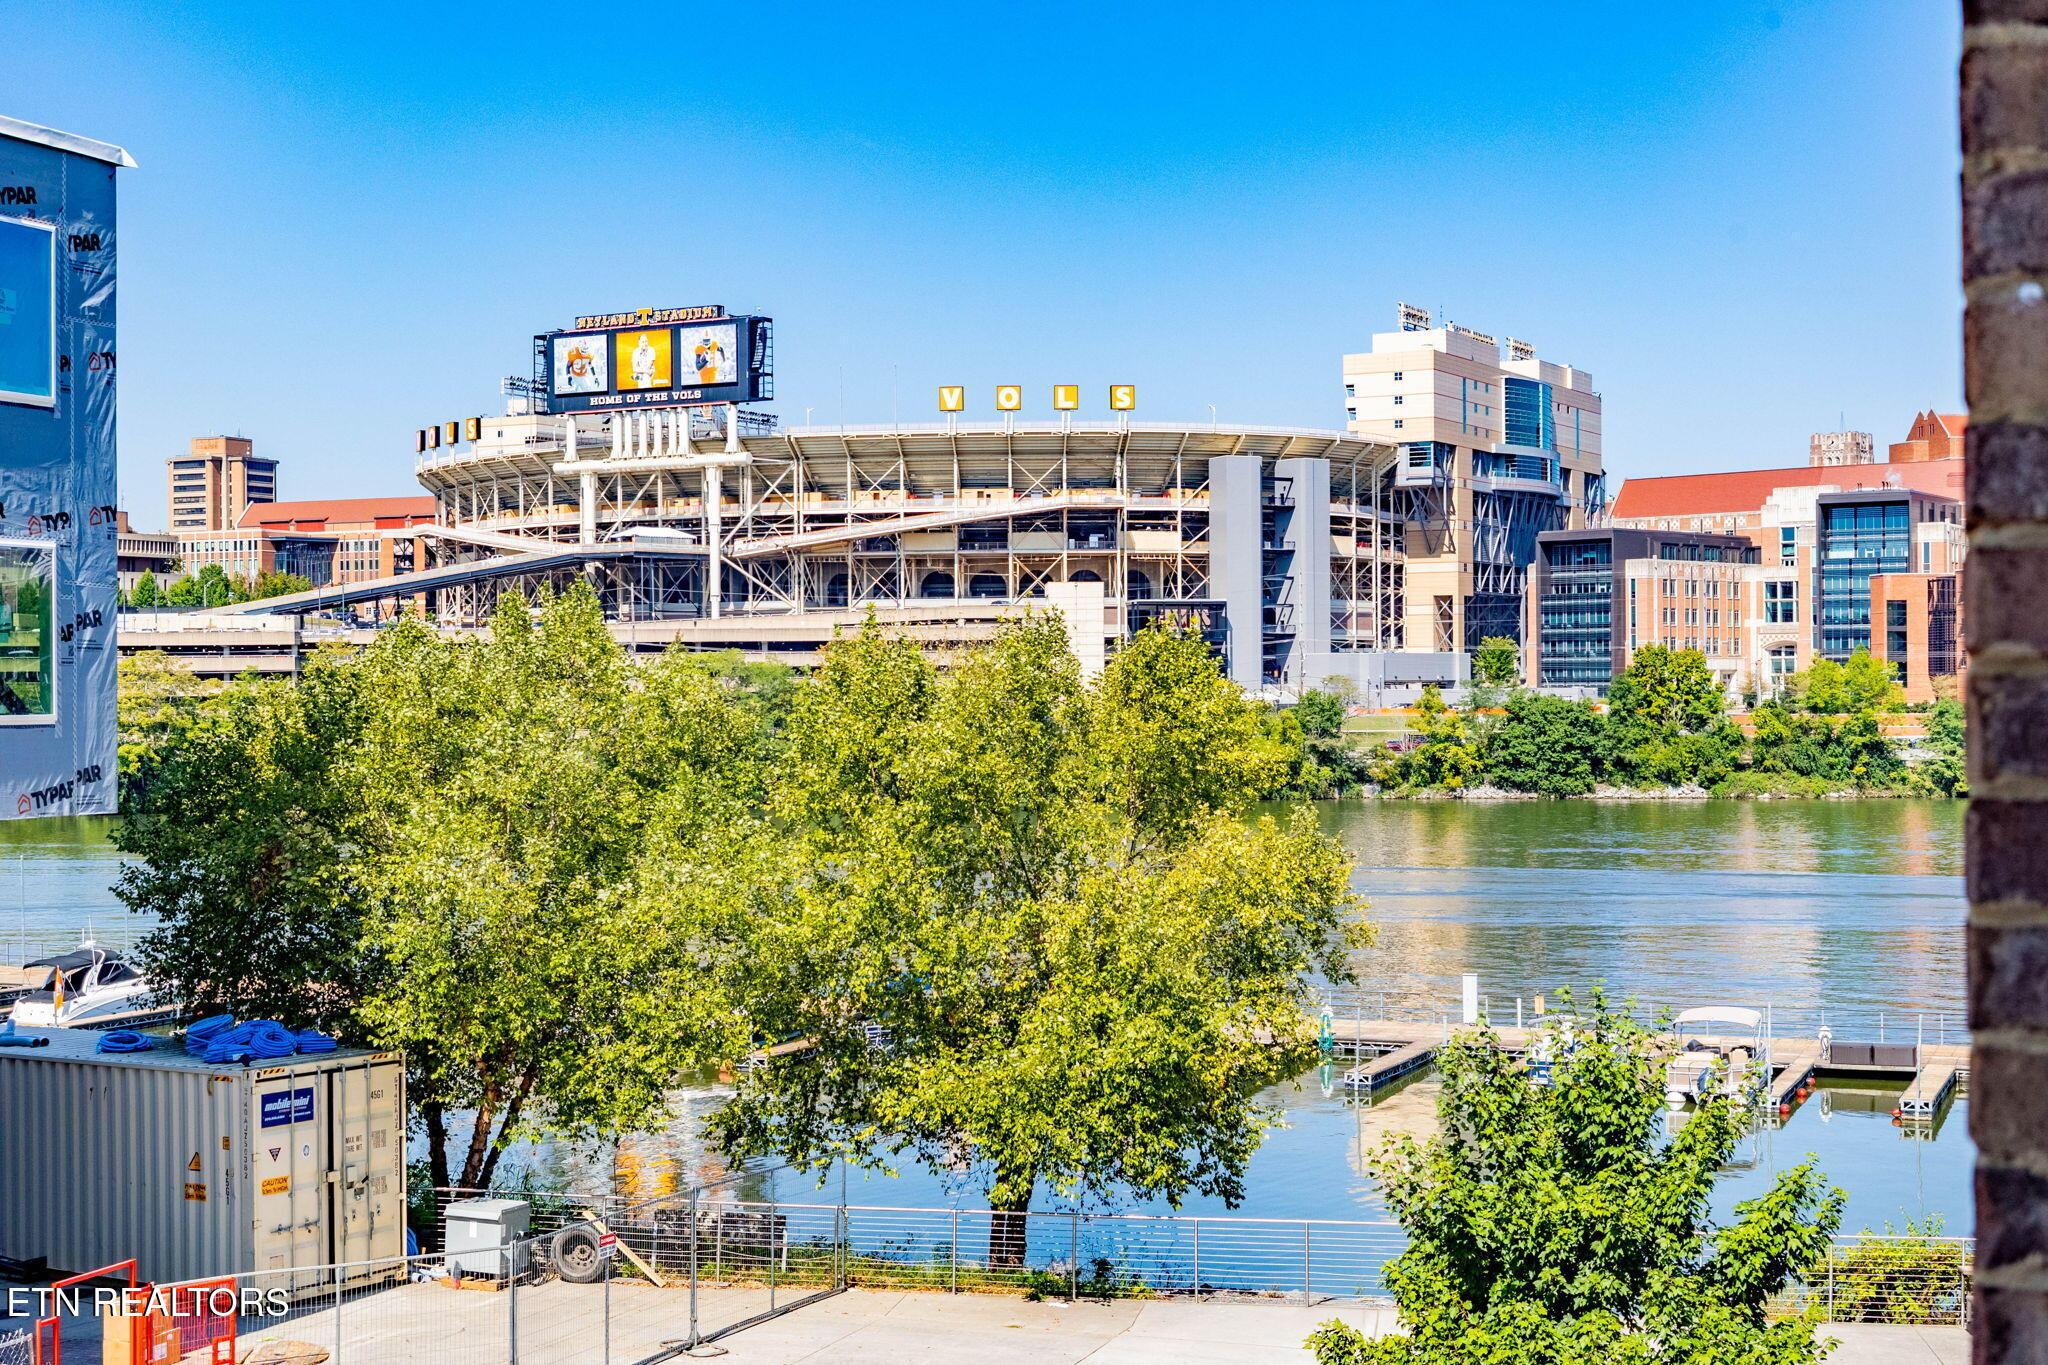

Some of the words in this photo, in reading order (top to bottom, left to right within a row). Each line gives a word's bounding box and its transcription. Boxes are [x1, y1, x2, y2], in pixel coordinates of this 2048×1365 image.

[652, 307, 714, 323] STADIUM
[590, 395, 623, 406] HOME
[626, 394, 641, 403] OF
[645, 392, 668, 402] THE
[672, 390, 702, 400] VOLS
[941, 387, 1131, 409] VOLS
[41, 512, 72, 532] TYP
[371, 1089, 384, 1100] 45G1
[264, 1098, 292, 1112] mobile
[262, 1177, 288, 1187] CAUTION
